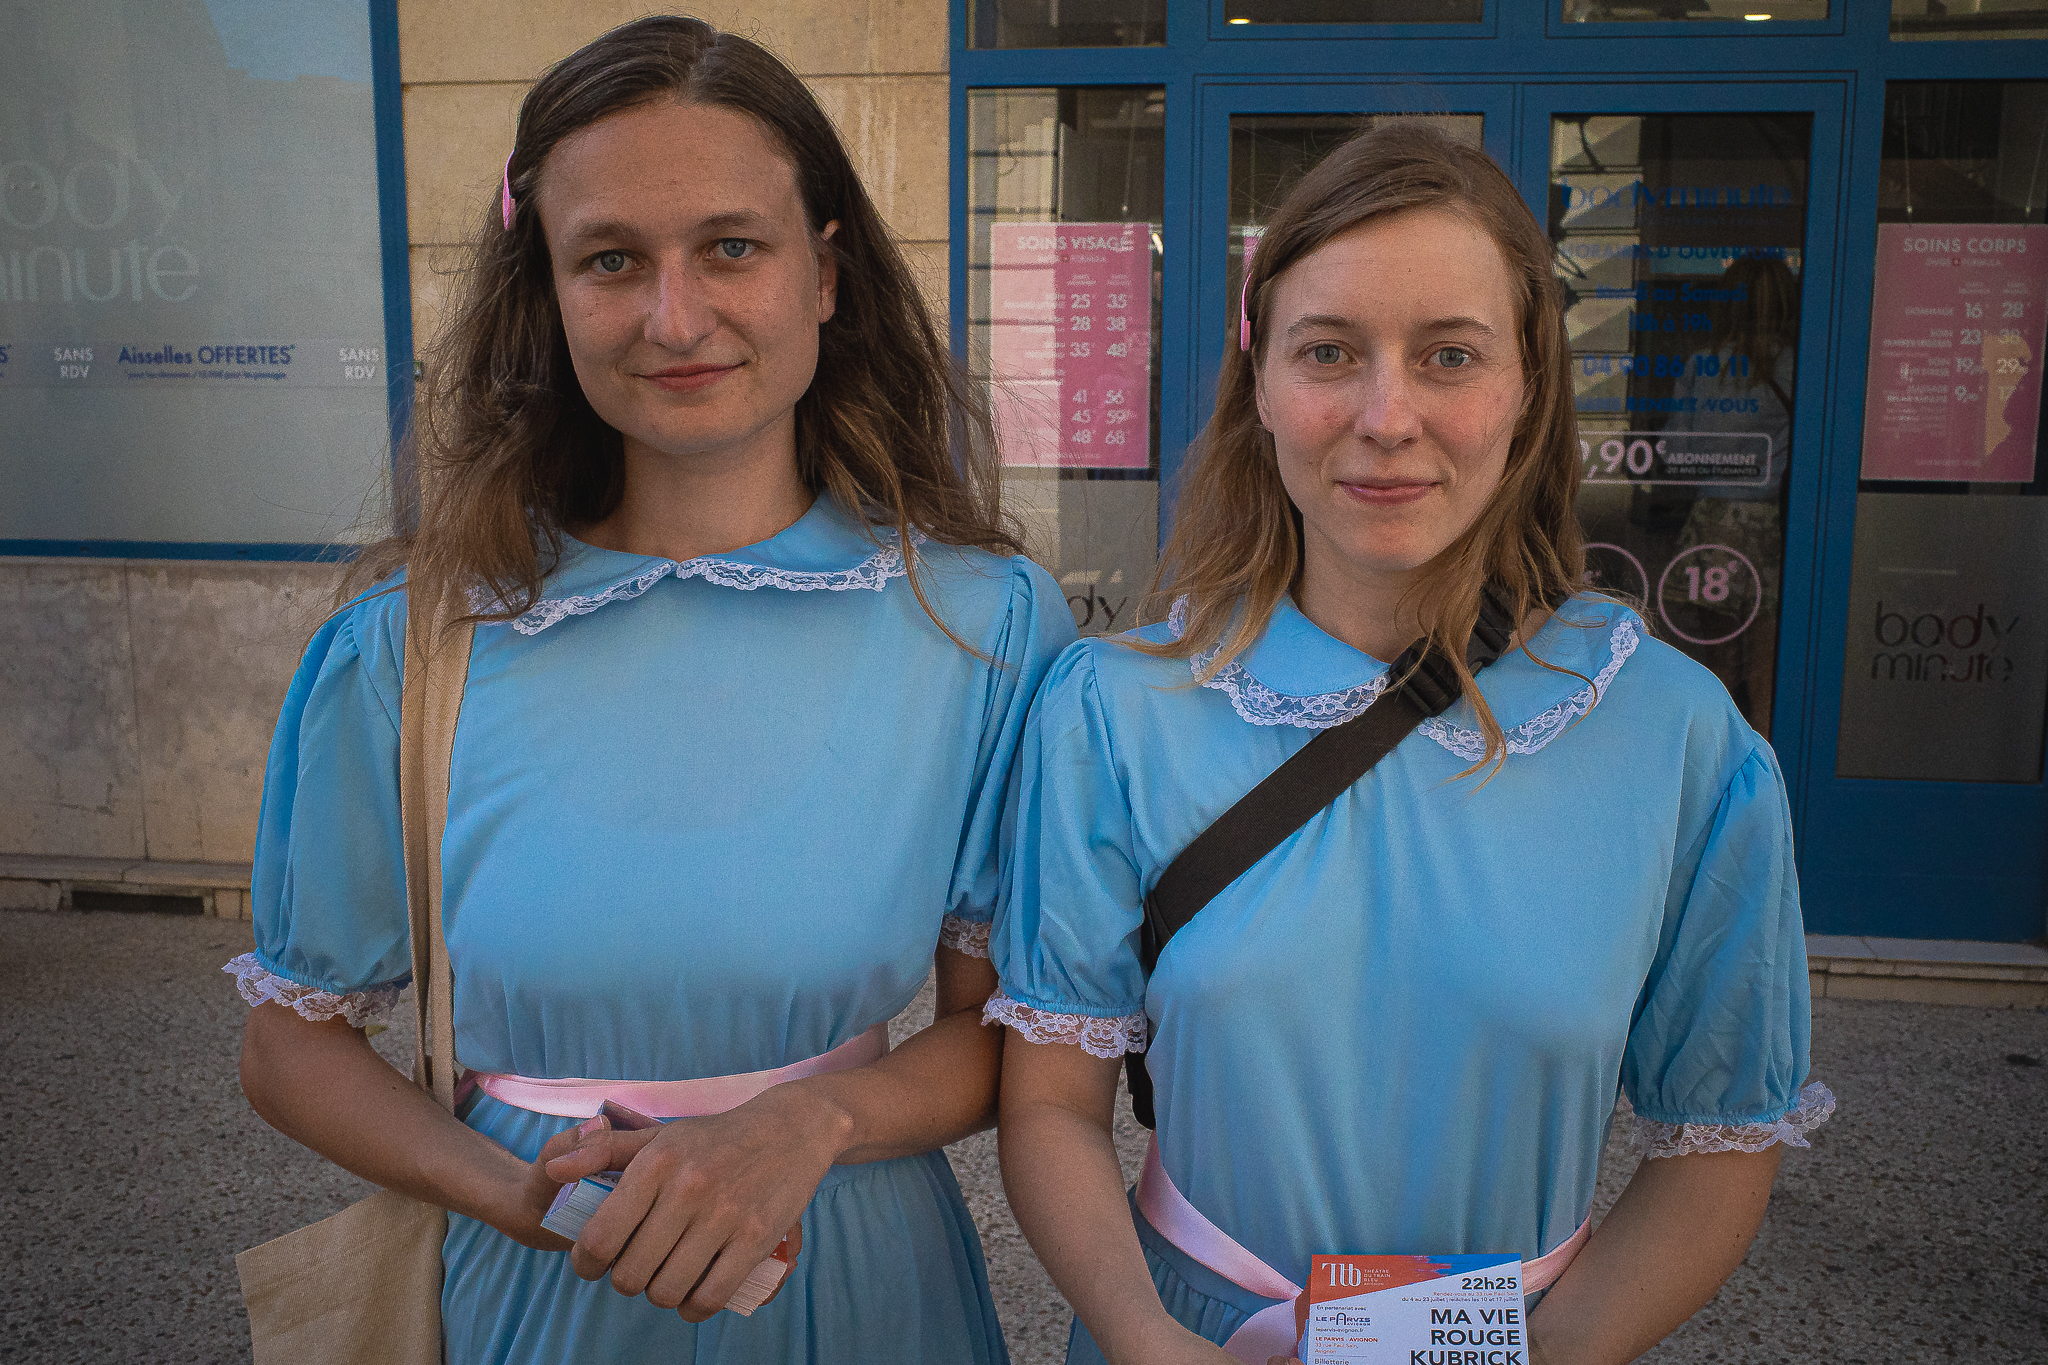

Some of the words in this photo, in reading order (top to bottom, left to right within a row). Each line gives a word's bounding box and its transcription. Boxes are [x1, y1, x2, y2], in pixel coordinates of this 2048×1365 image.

[0, 158, 183, 239] ody
[1017, 236, 1067, 250] SOINS
[1070, 236, 1129, 251] VISAGE
[1903, 238, 1961, 253] SOINS
[1967, 238, 2027, 253] CORPS
[0, 237, 199, 302] inute
[1653, 288, 1675, 302] au
[1681, 282, 1747, 302] Samedi
[1663, 314, 1675, 332] à
[1683, 312, 1712, 332] 19h
[53, 347, 94, 363] SANS
[118, 344, 193, 365] Aisselles
[338, 347, 380, 363] SANS
[59, 364, 91, 380] RDV
[344, 364, 376, 380] RDV
[1618, 355, 1649, 377] 90
[1654, 355, 1685, 378] 86
[1697, 355, 1719, 377] 10
[1728, 355, 1748, 377] 11
[1667, 453, 1757, 465] ABONNEMENT
[1685, 560, 1738, 602] 18€
[1067, 585, 1128, 631] dy
[1875, 600, 2020, 653] body
[1871, 652, 2014, 683] minute
[1462, 1277, 1517, 1290] 22h25
[1330, 1312, 1370, 1325] PARVIS
[1431, 1309, 1472, 1325] MA
[1478, 1309, 1519, 1325] VIE
[1431, 1329, 1521, 1346] ROUGE
[1411, 1350, 1522, 1365] KUBRICK
